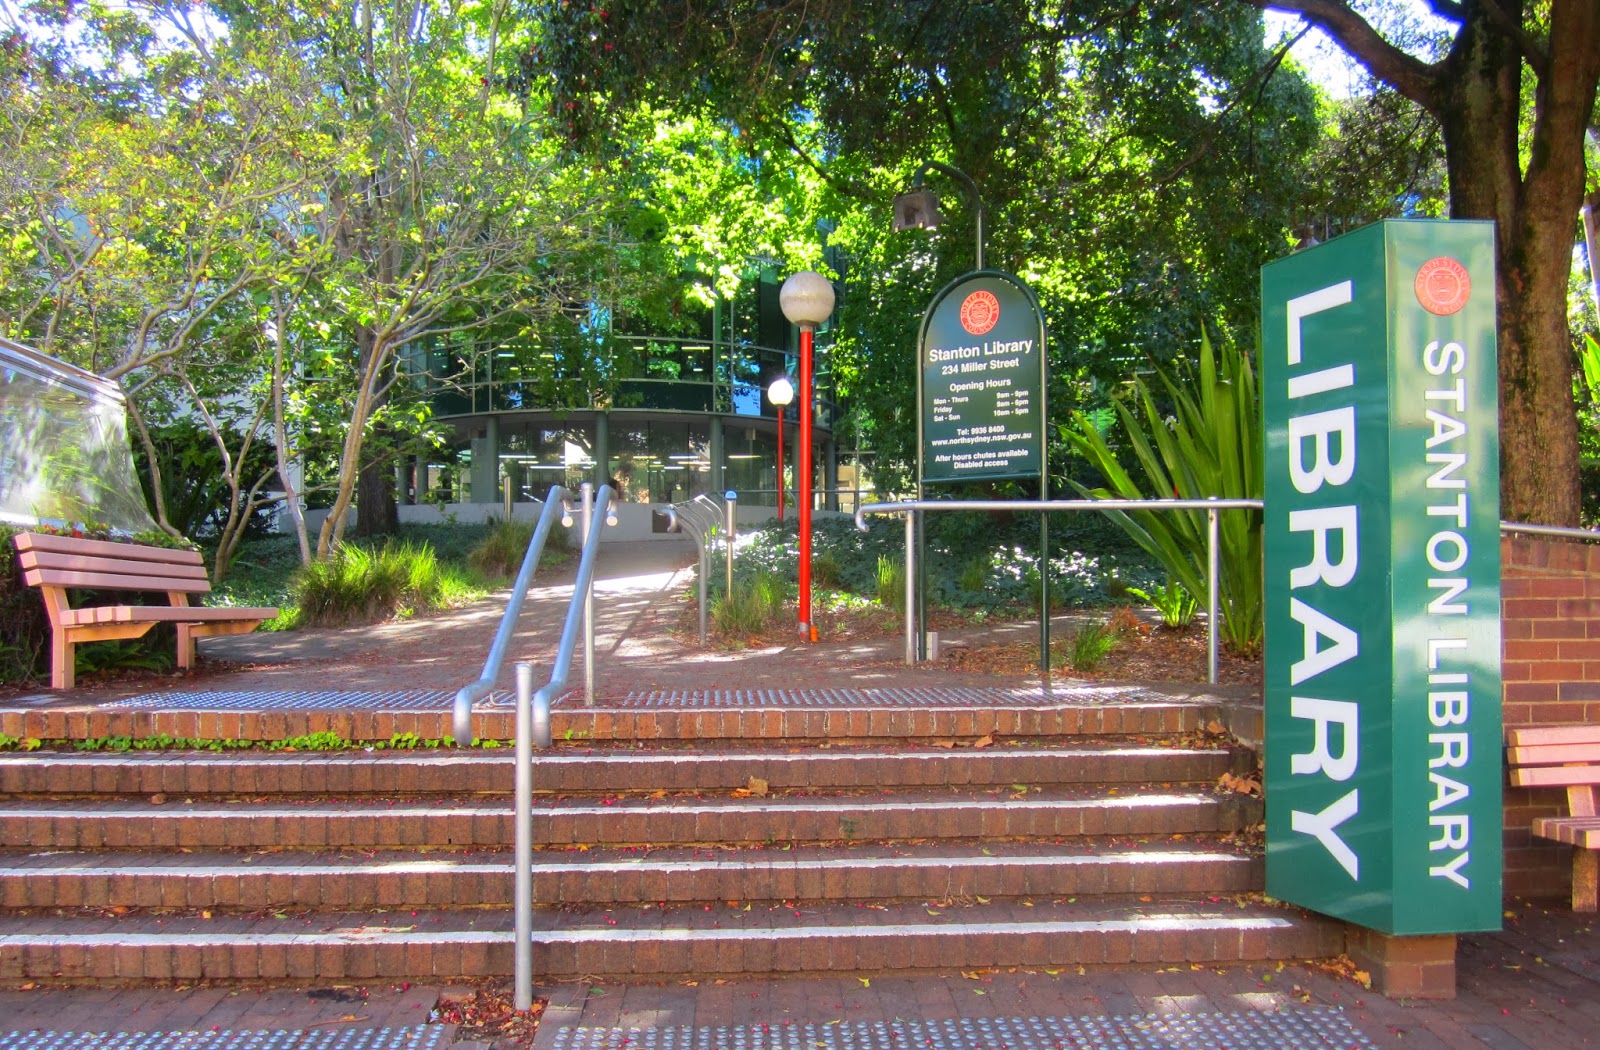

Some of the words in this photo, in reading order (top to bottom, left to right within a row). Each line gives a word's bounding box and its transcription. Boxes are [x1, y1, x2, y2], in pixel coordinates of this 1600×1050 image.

[929, 346, 980, 362] Stanton
[984, 340, 1033, 356] Library
[942, 364, 959, 375] 234
[961, 362, 987, 373] Miller
[989, 357, 1019, 369] Street
[949, 381, 984, 393] Opening
[986, 378, 1012, 388] Hours
[933, 406, 953, 414] Friday
[993, 409, 1010, 417] 10am
[957, 428, 970, 436] Tel:
[971, 427, 987, 435] 9936
[988, 425, 1005, 433] 8400
[931, 432, 1032, 446] www.northsydney.nsw.gov.au
[935, 454, 952, 463] After
[952, 453, 972, 461] hours
[973, 451, 997, 459] chutes
[997, 449, 1029, 458] available
[953, 460, 983, 469] Disabled
[984, 459, 1008, 467] access
[1423, 340, 1470, 615] STANTON
[1287, 280, 1360, 881] LIBRARY
[1426, 638, 1470, 889] LIBRARY
